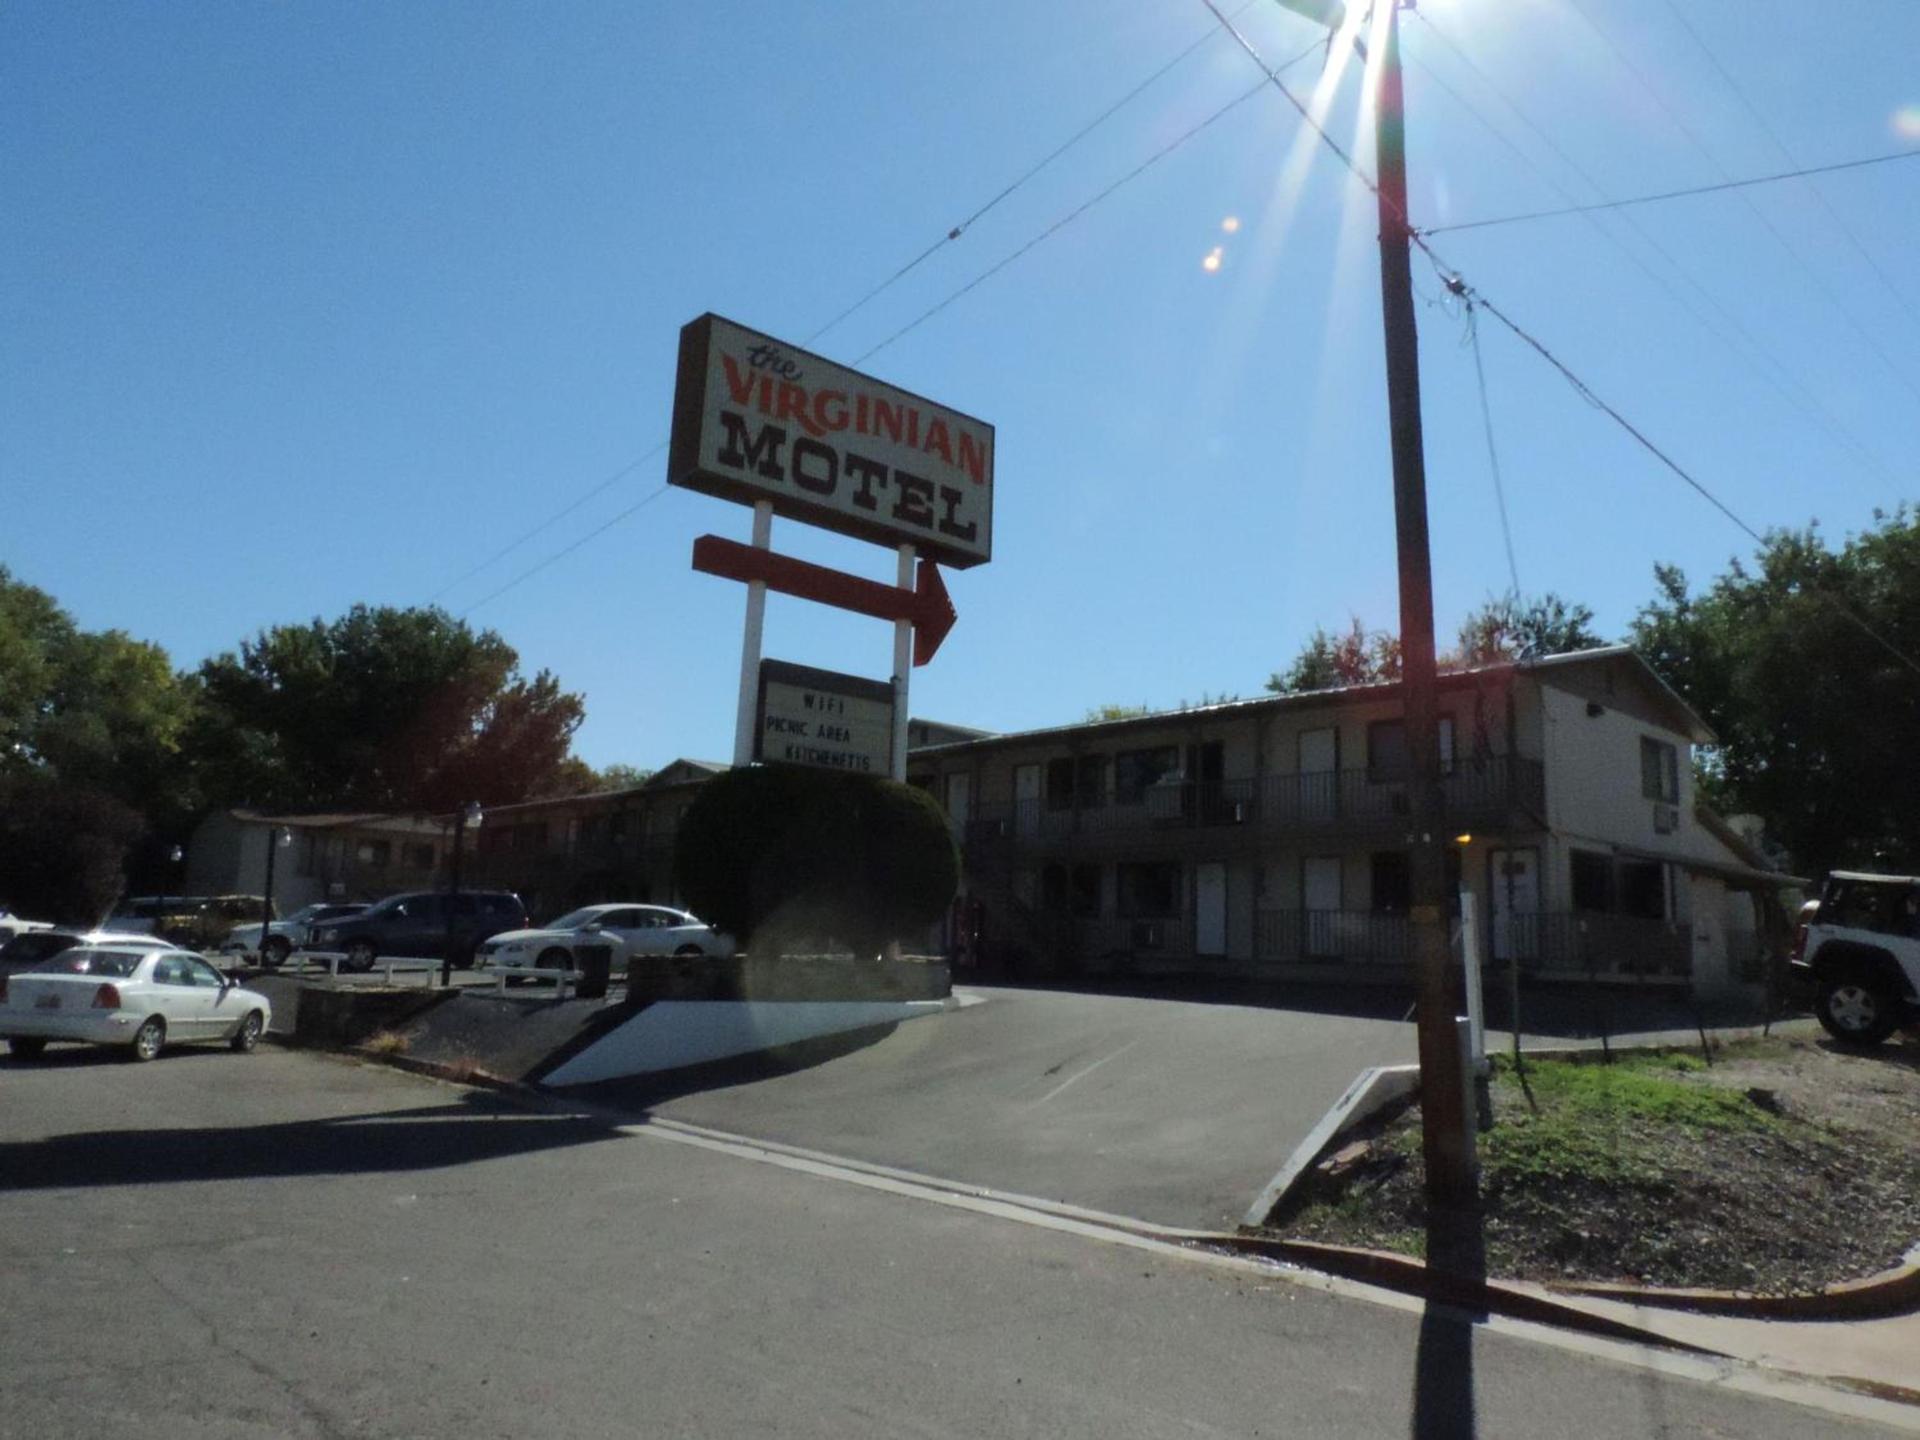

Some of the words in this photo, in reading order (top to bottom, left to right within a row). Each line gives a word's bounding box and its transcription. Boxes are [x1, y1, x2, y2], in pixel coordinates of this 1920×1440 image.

[746, 343, 803, 380] the
[722, 354, 987, 486] VIRGINIAN
[718, 410, 977, 543] MOTEL
[803, 693, 844, 715] WIFI
[766, 715, 808, 737] PICNIC
[817, 724, 850, 744] AREA
